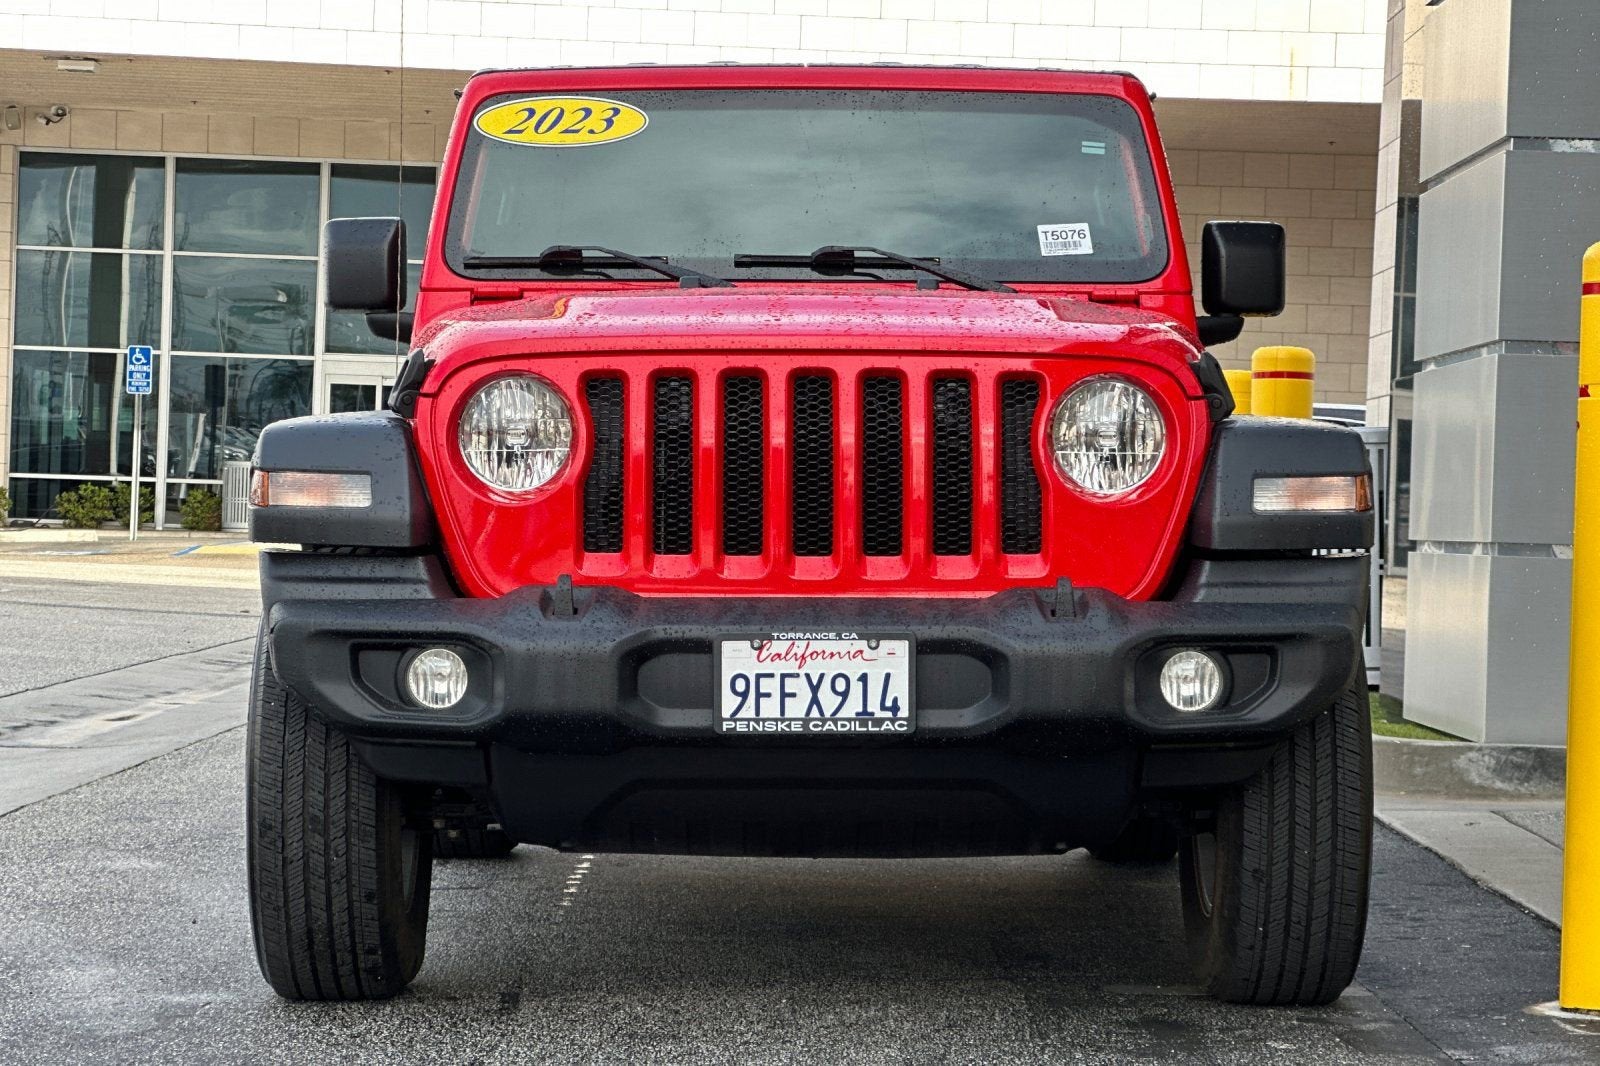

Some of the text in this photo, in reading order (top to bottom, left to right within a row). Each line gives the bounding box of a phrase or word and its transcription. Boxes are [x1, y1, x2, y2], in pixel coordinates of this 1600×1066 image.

[502, 106, 621, 135] 2023
[1041, 229, 1087, 241] T5076
[771, 632, 859, 641] TORRANCE, CA
[756, 639, 878, 669] California
[729, 672, 901, 718] 9FFX914
[722, 720, 908, 732] PENSKE CADILLAC
